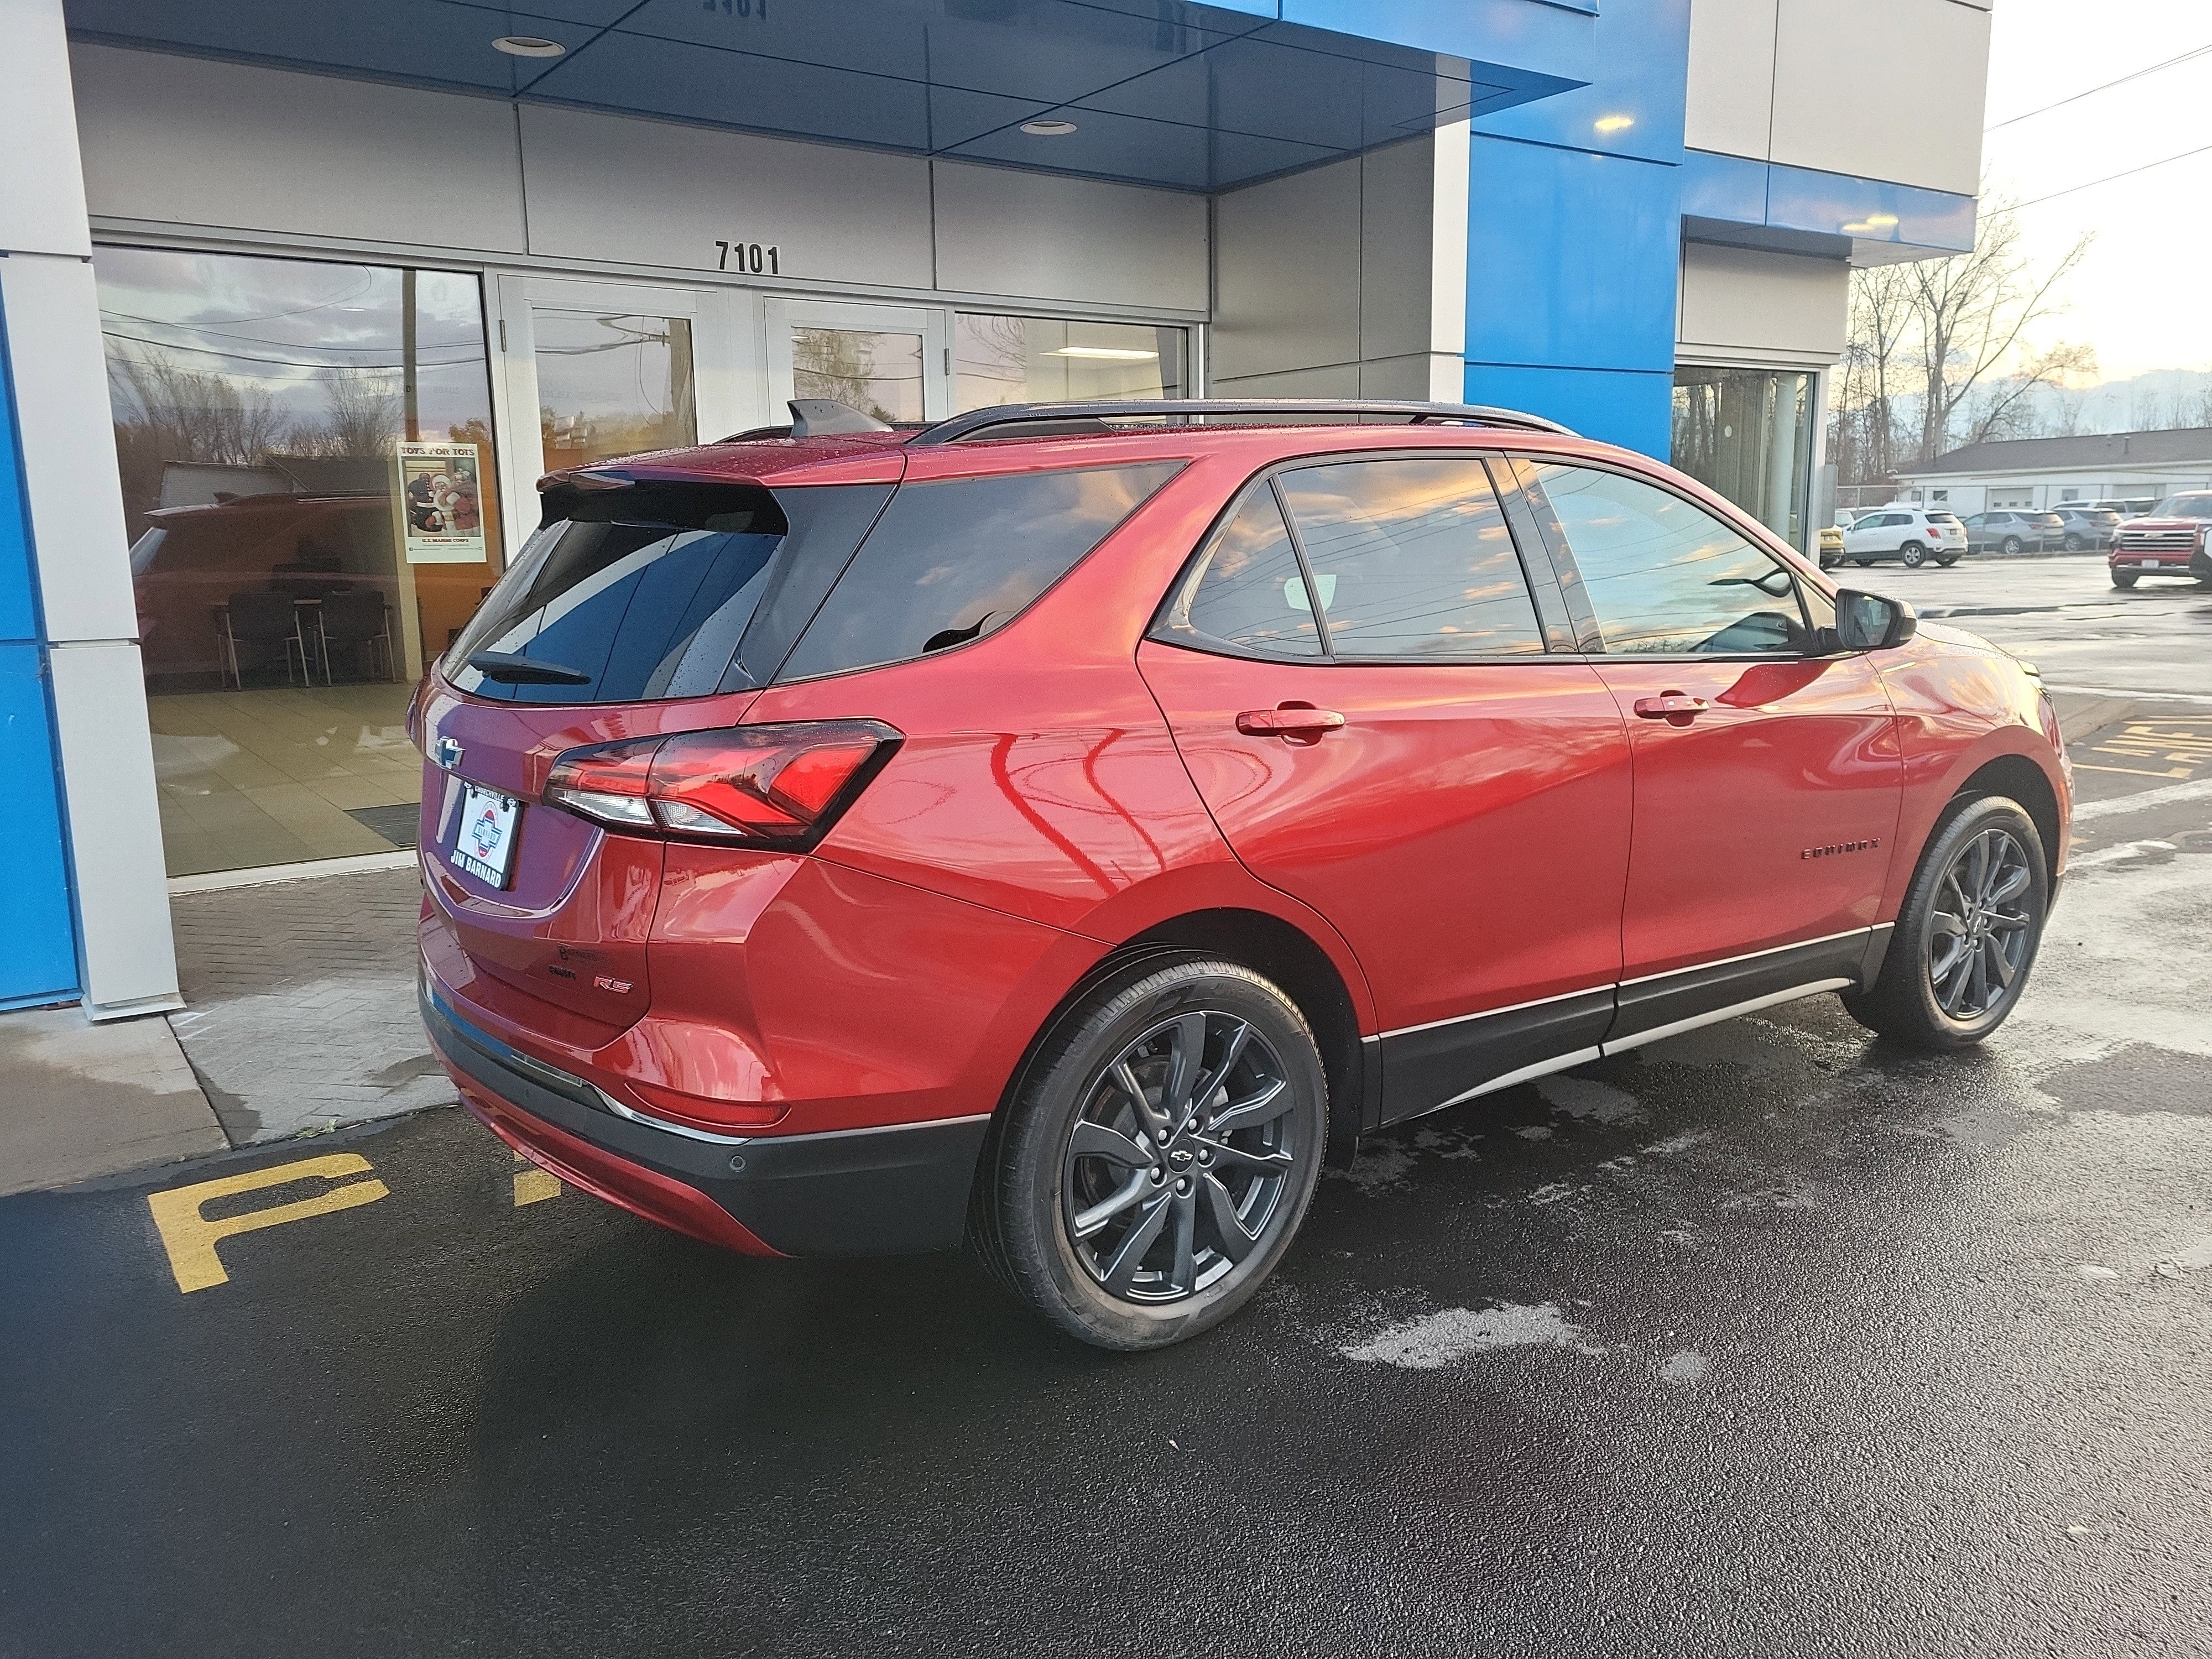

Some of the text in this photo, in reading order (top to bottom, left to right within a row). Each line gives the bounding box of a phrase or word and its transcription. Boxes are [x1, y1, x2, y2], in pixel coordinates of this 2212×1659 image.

[715, 240, 779, 275] 7101
[474, 785, 505, 802] CHURCHVILLE
[451, 849, 502, 888] JIM BARNARD
[593, 974, 634, 994] RS
